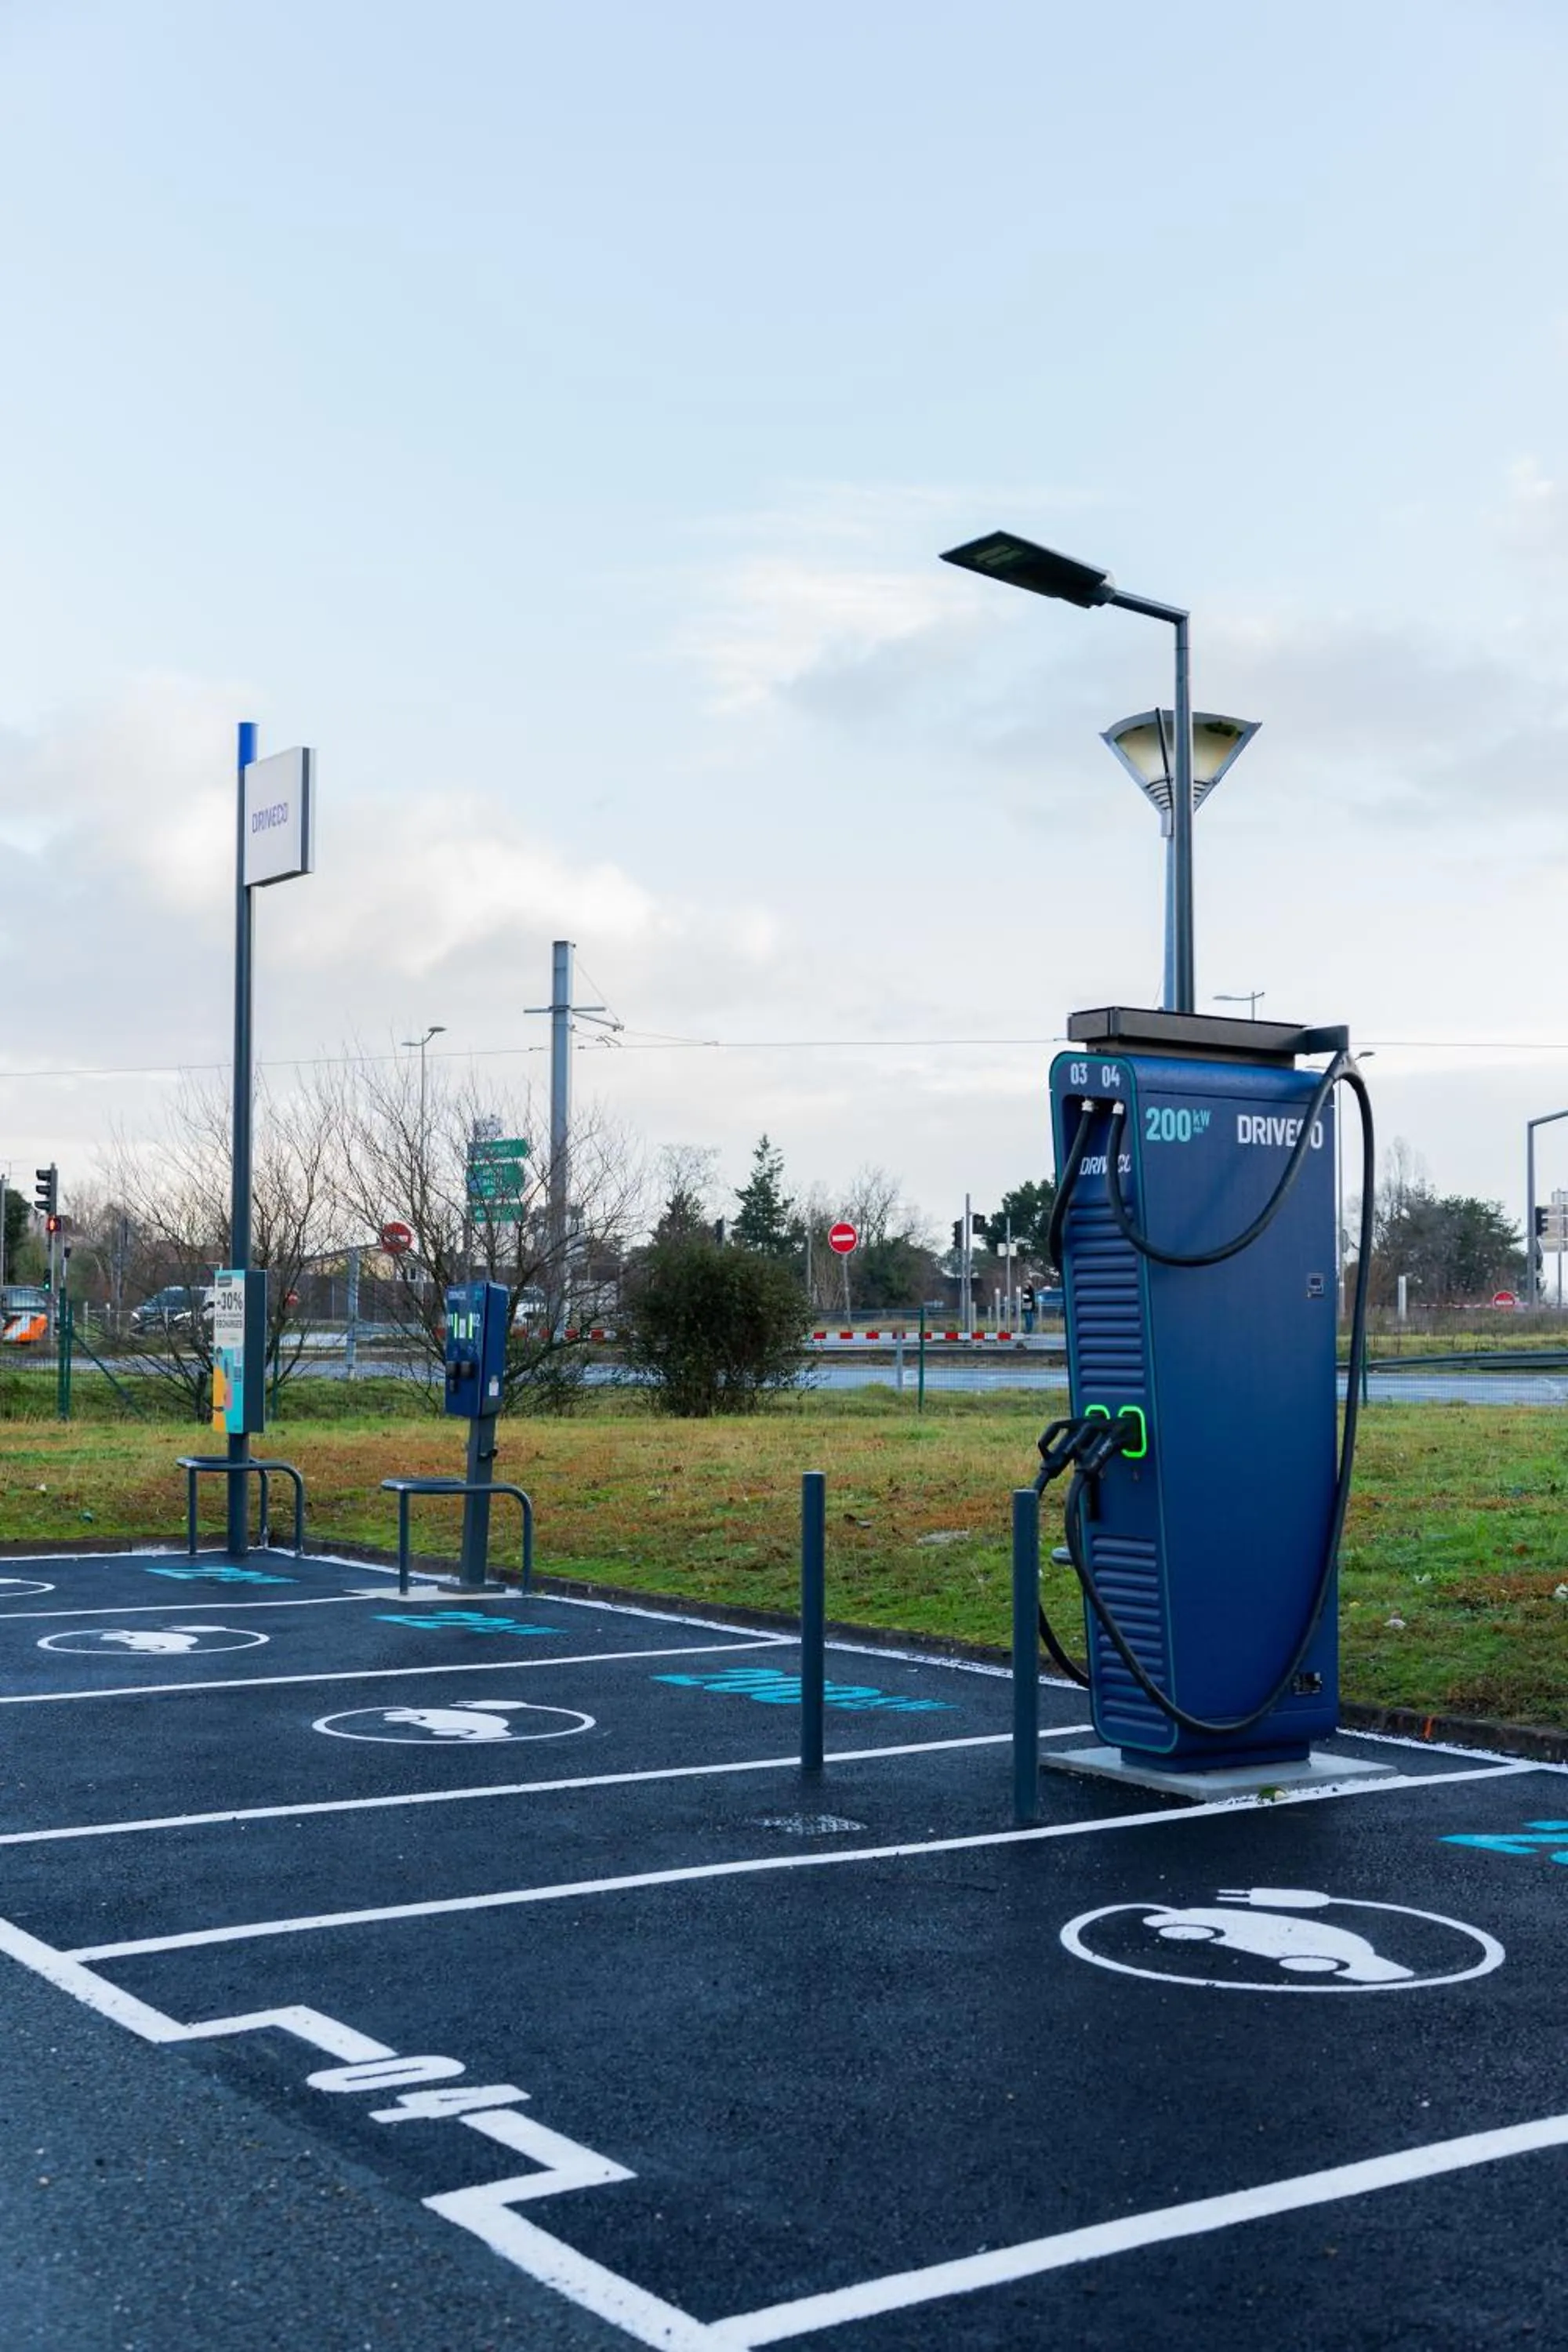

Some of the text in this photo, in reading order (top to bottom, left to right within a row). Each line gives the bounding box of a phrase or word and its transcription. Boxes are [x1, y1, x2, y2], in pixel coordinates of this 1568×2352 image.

[1070, 1062, 1120, 1088] 03 04
[1145, 1107, 1191, 1142] 200
